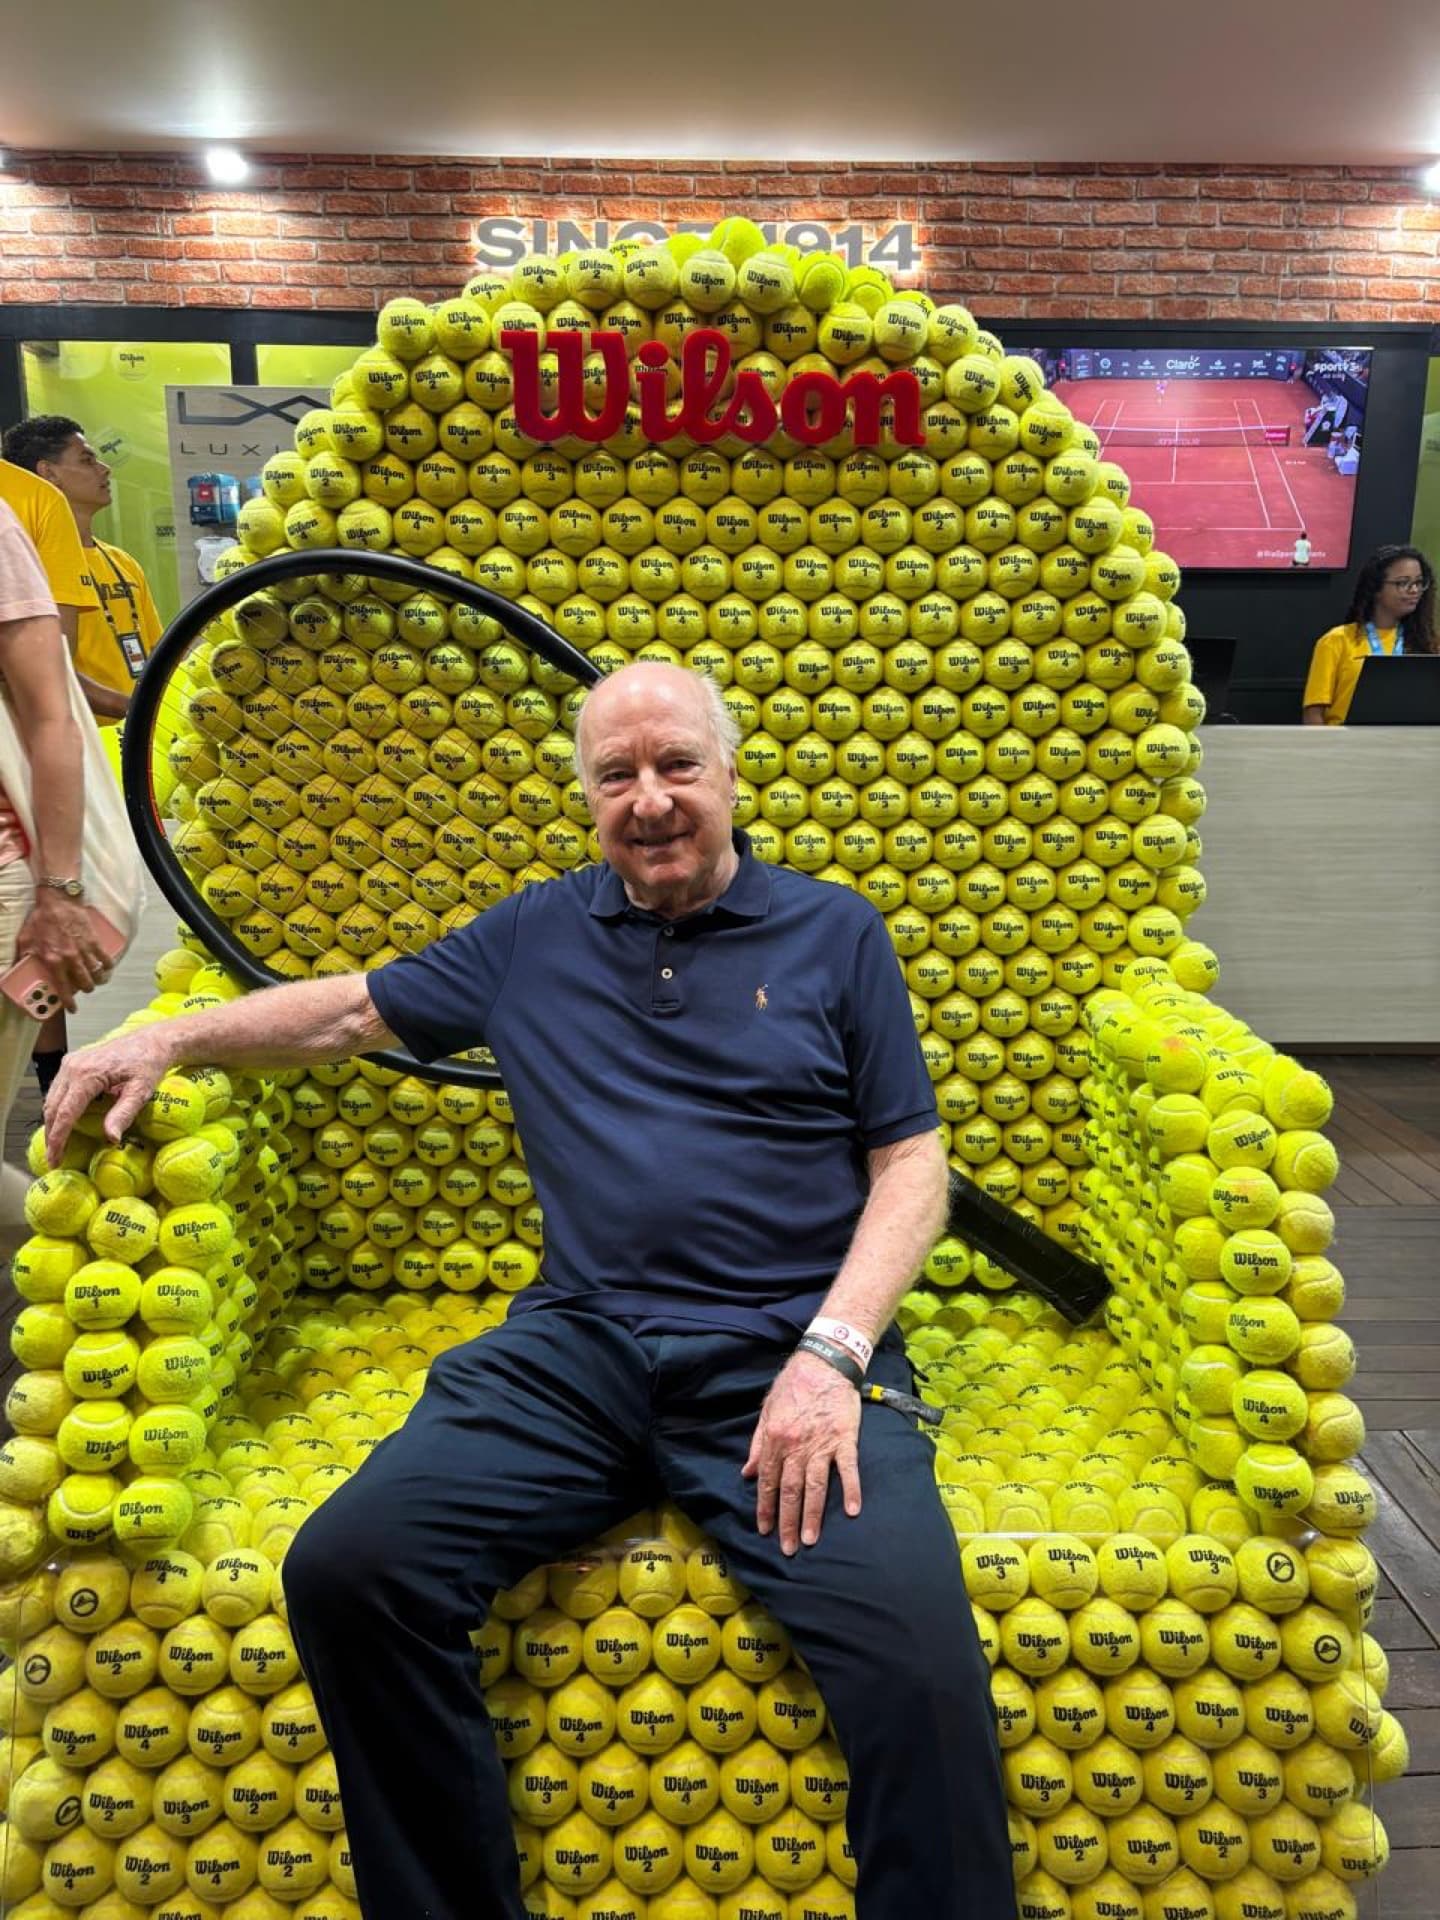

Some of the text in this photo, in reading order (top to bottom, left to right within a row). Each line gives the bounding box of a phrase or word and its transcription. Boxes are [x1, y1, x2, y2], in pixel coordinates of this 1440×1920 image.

[475, 218, 712, 267] SIN
[523, 266, 557, 277] Wilson
[579, 260, 614, 271] Wilson
[691, 273, 725, 286] Wilson
[747, 270, 780, 287] Wilson
[391, 315, 425, 326] Wilson
[832, 328, 865, 342] Wilson
[1166, 359, 1196, 370] Claro
[369, 372, 404, 383] Wilson
[476, 372, 510, 384] Wilson
[501, 329, 926, 446] Wilson
[388, 425, 422, 436] Wilson
[311, 468, 344, 478] Wilson
[534, 463, 567, 473] Wilson
[688, 463, 721, 473] Wilson
[1007, 464, 1040, 475] Wilson
[402, 511, 434, 523] Wilson
[449, 516, 482, 525] Wilson
[768, 514, 801, 525] Wilson
[1030, 511, 1062, 522] Wilson
[1057, 558, 1088, 568] Wilson
[821, 606, 852, 616] Wilson
[1022, 602, 1055, 612] Wilson
[405, 608, 437, 619] Wilson
[773, 704, 804, 714] Wilson
[1147, 744, 1180, 753] Wilson
[744, 751, 776, 760] Wilson
[797, 750, 828, 760] Wilson
[1143, 836, 1176, 847] Wilson
[868, 881, 900, 890] Wilson
[1068, 875, 1100, 884] Wilson
[208, 888, 242, 899] Wilson
[1041, 1003, 1072, 1012] Wilson
[1213, 1190, 1249, 1203] Wilson
[1224, 1202, 1232, 1212] 2
[105, 1211, 146, 1233] Wilson
[118, 1226, 127, 1237] 3
[173, 1222, 217, 1236] Wilson
[192, 1232, 200, 1243] 1
[1234, 1253, 1278, 1266] Wilson
[1253, 1267, 1259, 1276] 1
[75, 1286, 120, 1299] Wilson
[158, 1285, 199, 1297] Wilson
[92, 1298, 99, 1308] 1
[175, 1296, 180, 1306] 1
[83, 1364, 129, 1383] Wilson
[102, 1379, 111, 1389] 3
[1243, 1398, 1287, 1414] Wilson
[1259, 1414, 1269, 1424] 4
[144, 1428, 188, 1441] Wilson
[163, 1440, 168, 1451] 1
[1253, 1486, 1299, 1501] Wilson
[120, 1502, 163, 1517] Wilson
[1273, 1500, 1284, 1509] 4
[1357, 1504, 1364, 1514] 3
[133, 1515, 141, 1527] 4
[631, 1550, 672, 1563] Wilson
[1048, 1547, 1090, 1563] Wilson
[1189, 1548, 1232, 1565] Wilson
[216, 1558, 258, 1573] Wilson
[646, 1561, 655, 1572] 4
[976, 1554, 1019, 1569] Wilson
[1069, 1560, 1075, 1573] 1
[144, 1560, 187, 1577] Wilson
[996, 1565, 1006, 1579] 3
[1210, 1562, 1220, 1574] 3
[157, 1571, 166, 1584] 4
[230, 1568, 239, 1581] 3
[667, 1633, 709, 1648] Wilson
[1089, 1632, 1133, 1646] Wilson
[1235, 1634, 1277, 1650] Wilson
[526, 1642, 569, 1657] Wilson
[596, 1639, 639, 1653] Wilson
[1110, 1645, 1120, 1658] 2
[96, 1650, 142, 1664] Wilson
[169, 1646, 213, 1662] Wilson
[613, 1652, 622, 1664] 3
[684, 1647, 690, 1659] 1
[1254, 1649, 1264, 1661] 4
[183, 1661, 193, 1673] 4
[544, 1656, 550, 1668] 1
[112, 1662, 122, 1675] 2
[701, 1706, 744, 1723] Wilson
[1053, 1706, 1098, 1722] Wilson
[1196, 1701, 1239, 1718] Wilson
[560, 1717, 603, 1732] Wilson
[718, 1722, 727, 1734] 3
[1072, 1721, 1082, 1733] 4
[1216, 1717, 1223, 1728] 1
[52, 1728, 96, 1744] Wilson
[124, 1725, 169, 1739] Wilson
[576, 1731, 586, 1743] 4
[66, 1743, 77, 1755] 2
[140, 1738, 150, 1750] 4
[664, 1776, 707, 1792] Wilson
[1164, 1773, 1208, 1790] Wilson
[681, 1791, 691, 1805] 4
[1185, 1789, 1194, 1800] 2
[164, 1800, 210, 1815] Wilson
[182, 1814, 191, 1824] 3
[772, 1837, 816, 1852] Wilson
[1053, 1835, 1098, 1850] Wilson
[267, 1851, 312, 1865] Wilson
[791, 1851, 800, 1865] 2
[1075, 1848, 1084, 1862] 2
[51, 1862, 95, 1879] Wilson
[284, 1864, 293, 1877] 2
[64, 1878, 74, 1890] 4
